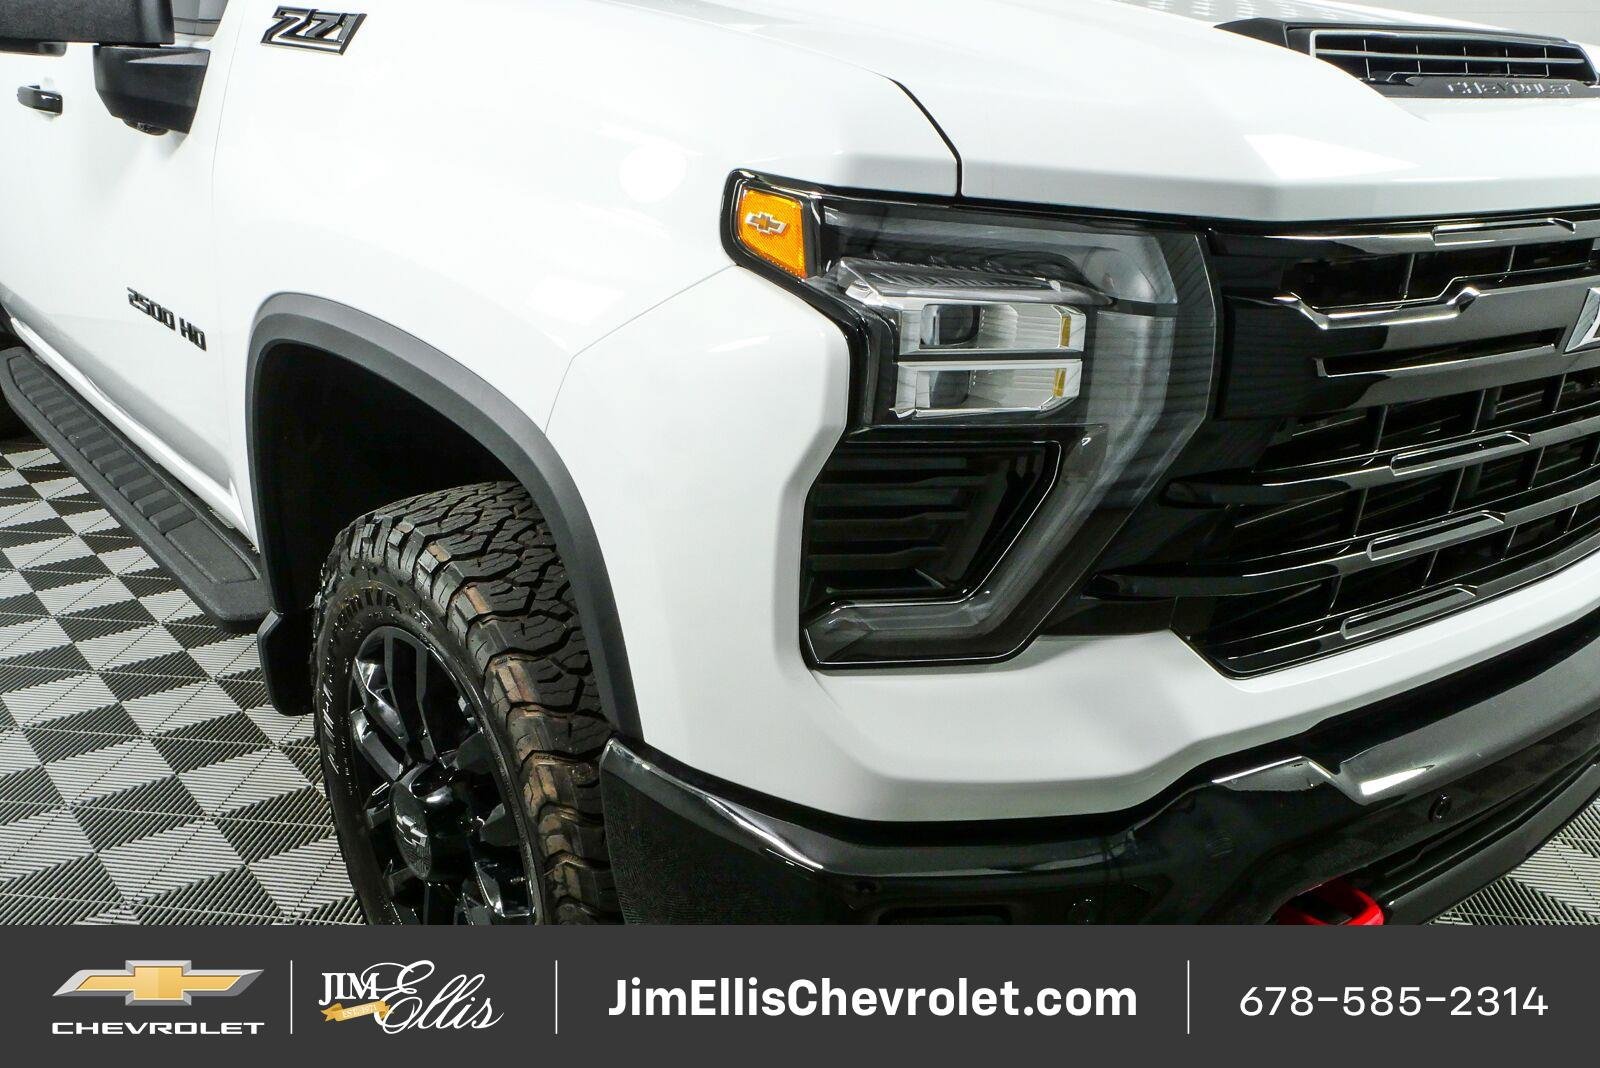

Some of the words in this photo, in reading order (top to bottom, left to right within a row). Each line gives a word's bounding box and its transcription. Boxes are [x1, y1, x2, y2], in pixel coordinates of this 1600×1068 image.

[260, 5, 367, 55] Z71
[1446, 81, 1574, 96] CHEVROLET
[126, 286, 176, 331] 2500
[178, 317, 207, 352] HD
